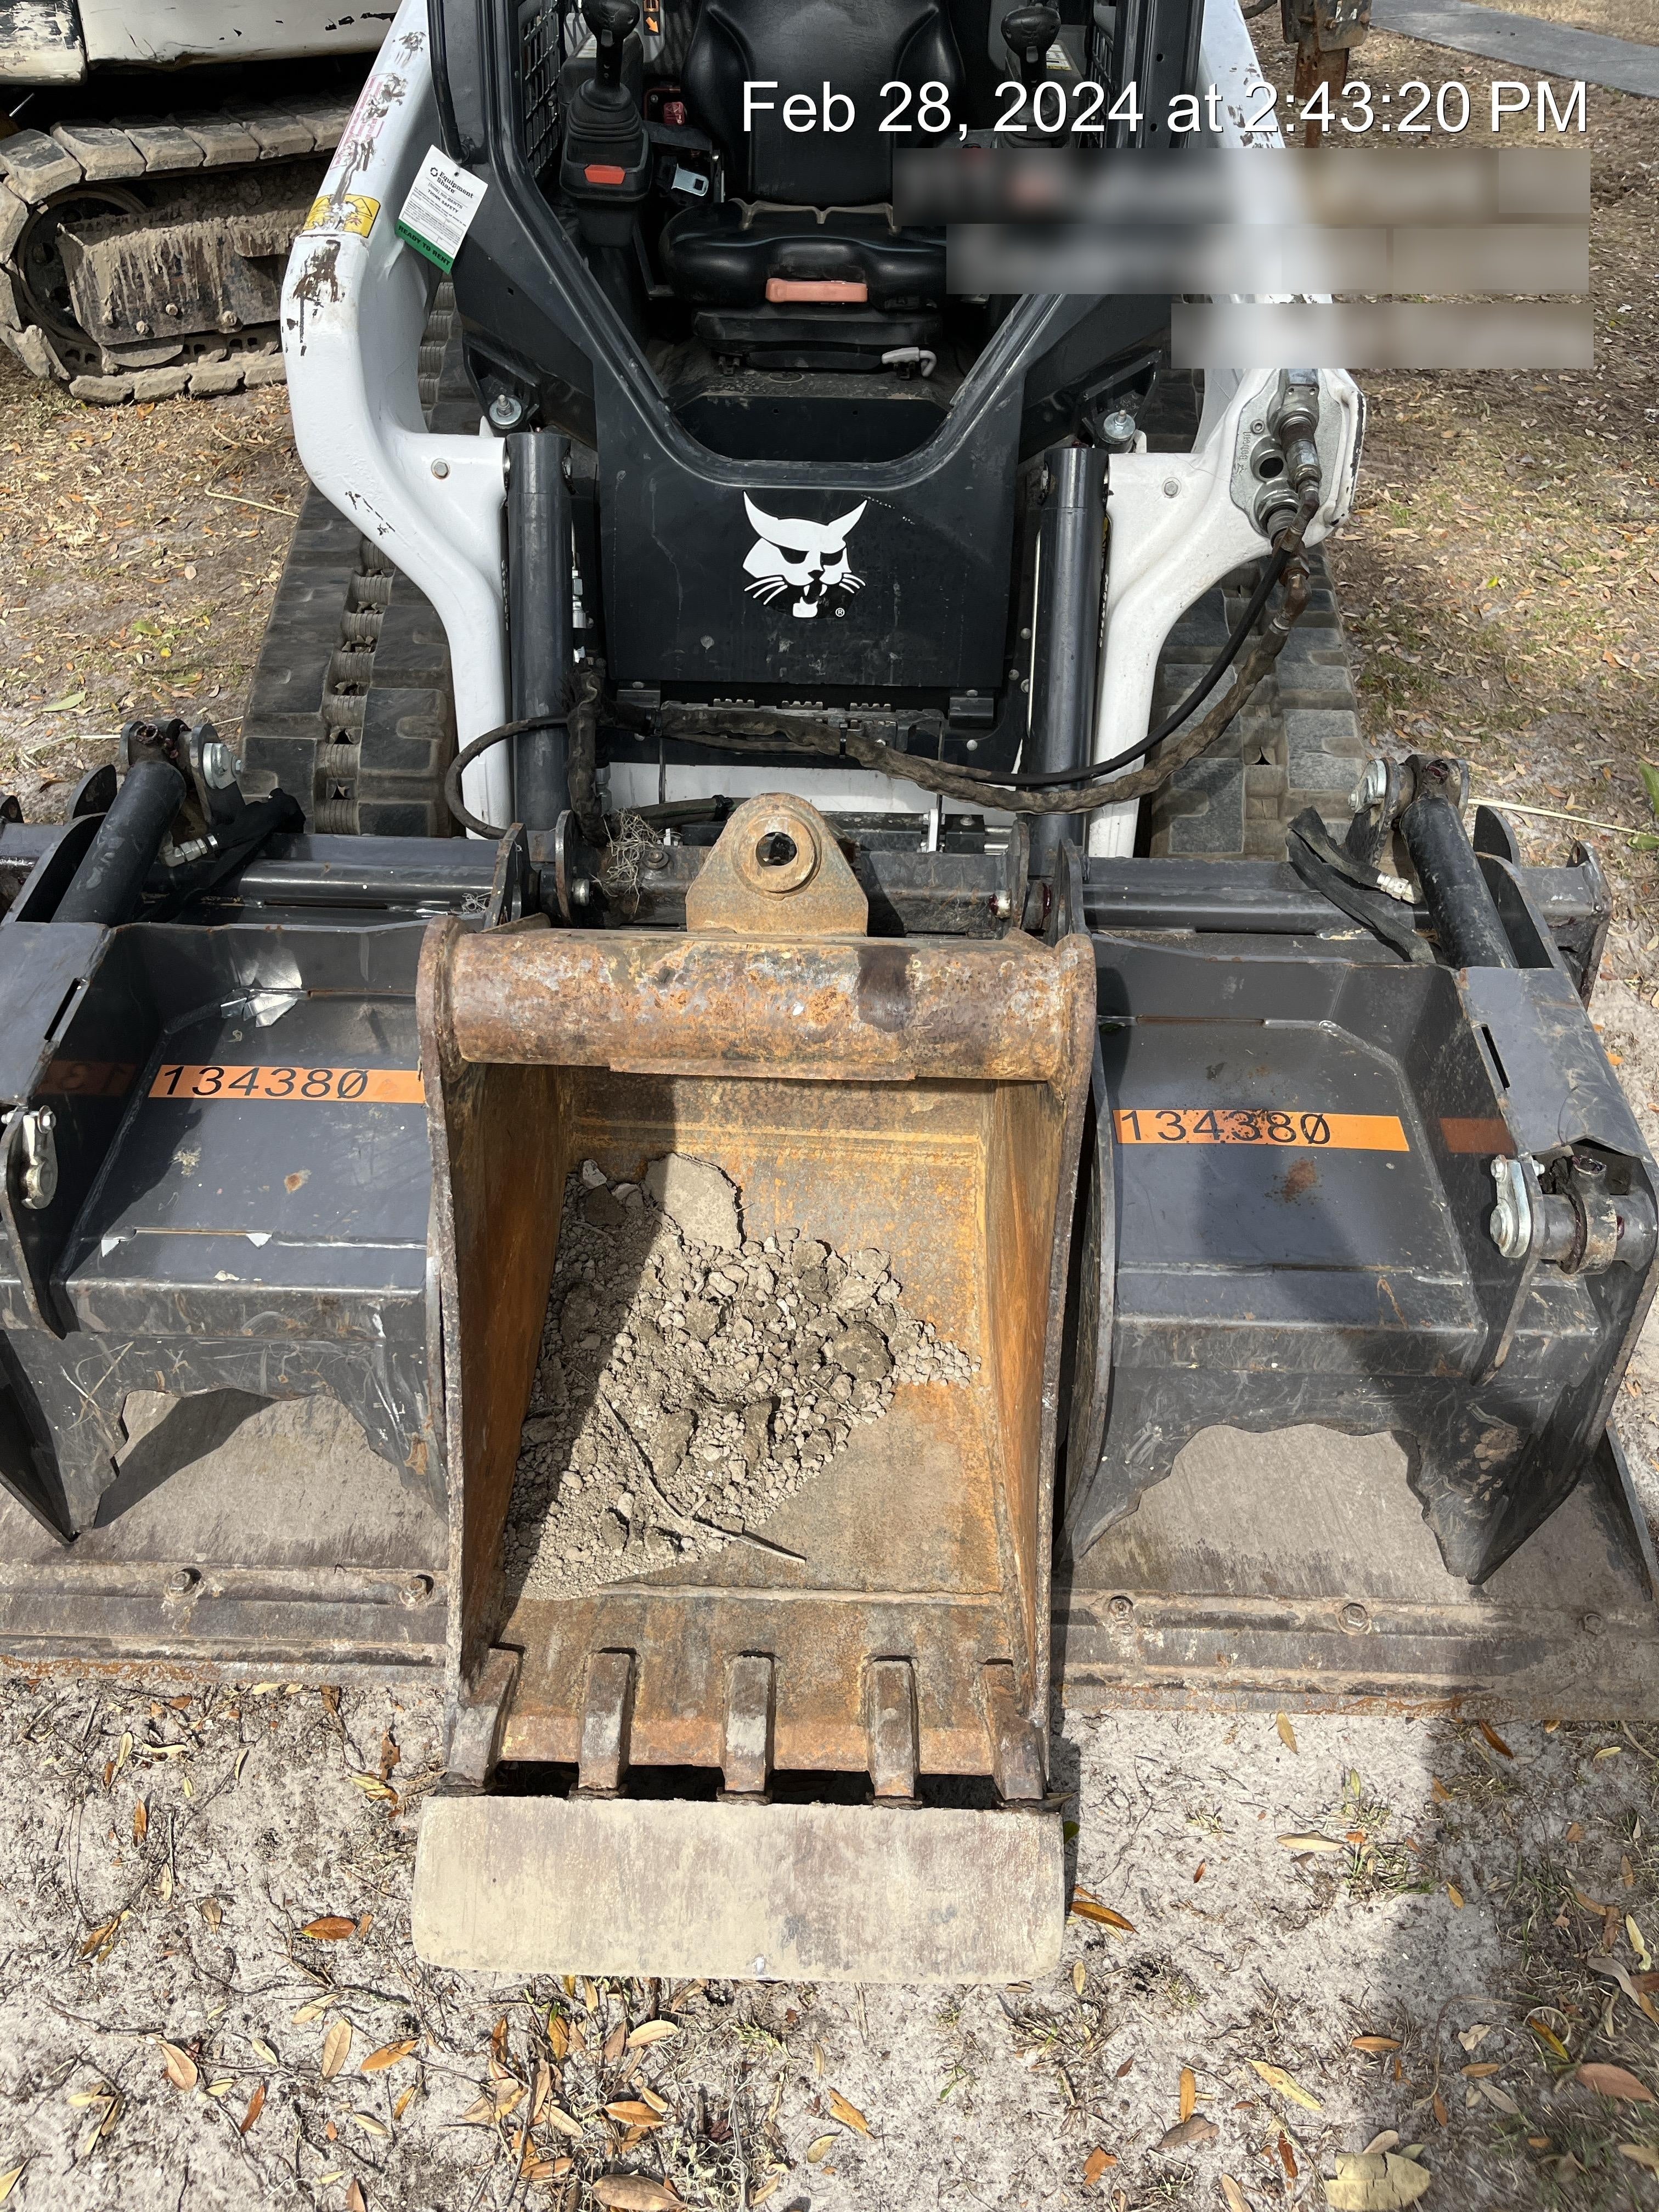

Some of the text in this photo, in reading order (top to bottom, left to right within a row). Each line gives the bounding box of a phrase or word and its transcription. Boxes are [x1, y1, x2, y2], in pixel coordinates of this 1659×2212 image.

[437, 177, 455, 193] Share
[439, 171, 473, 198] Equipment
[442, 200, 459, 213] SAFETY
[398, 225, 450, 266] READY TO RENT
